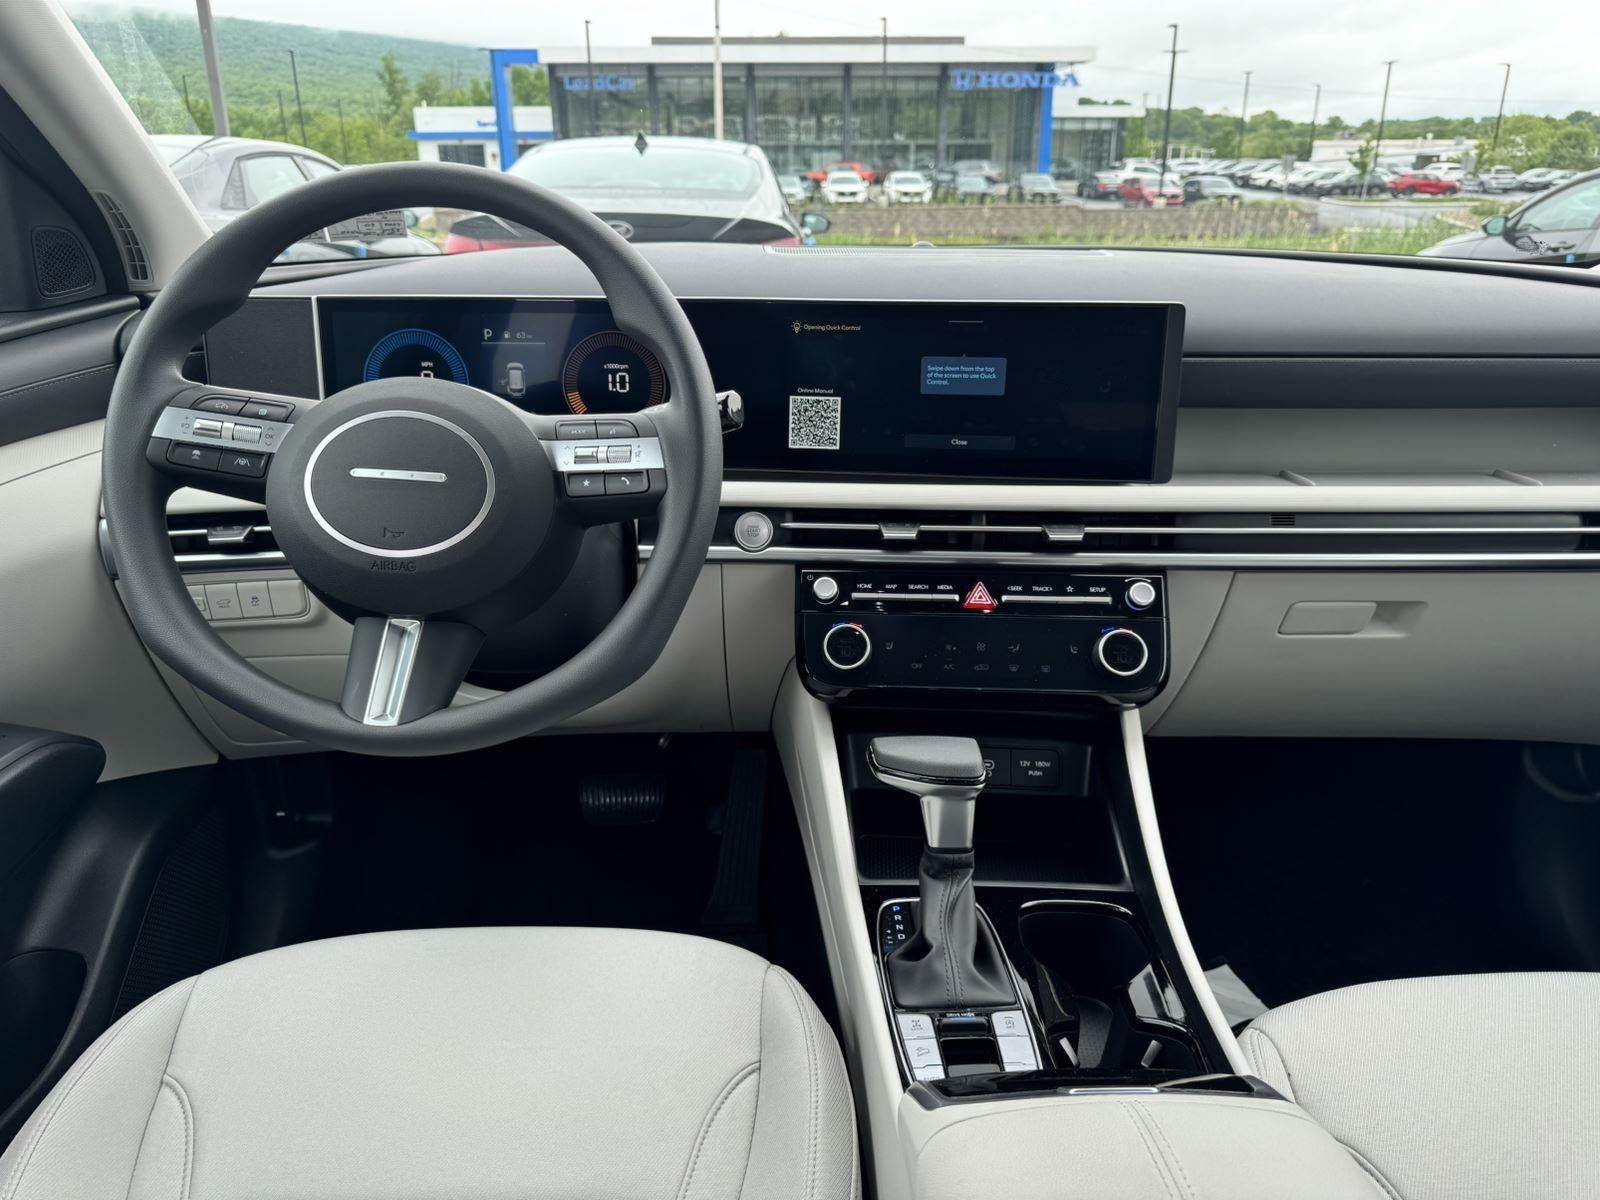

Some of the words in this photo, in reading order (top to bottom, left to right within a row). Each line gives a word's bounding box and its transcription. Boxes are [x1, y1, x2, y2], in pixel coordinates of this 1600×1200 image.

[979, 71, 1080, 89] HONDA
[483, 328, 493, 340] P
[516, 331, 526, 339] 63
[608, 372, 630, 393] 1.0
[370, 560, 417, 572] AIRBAG
